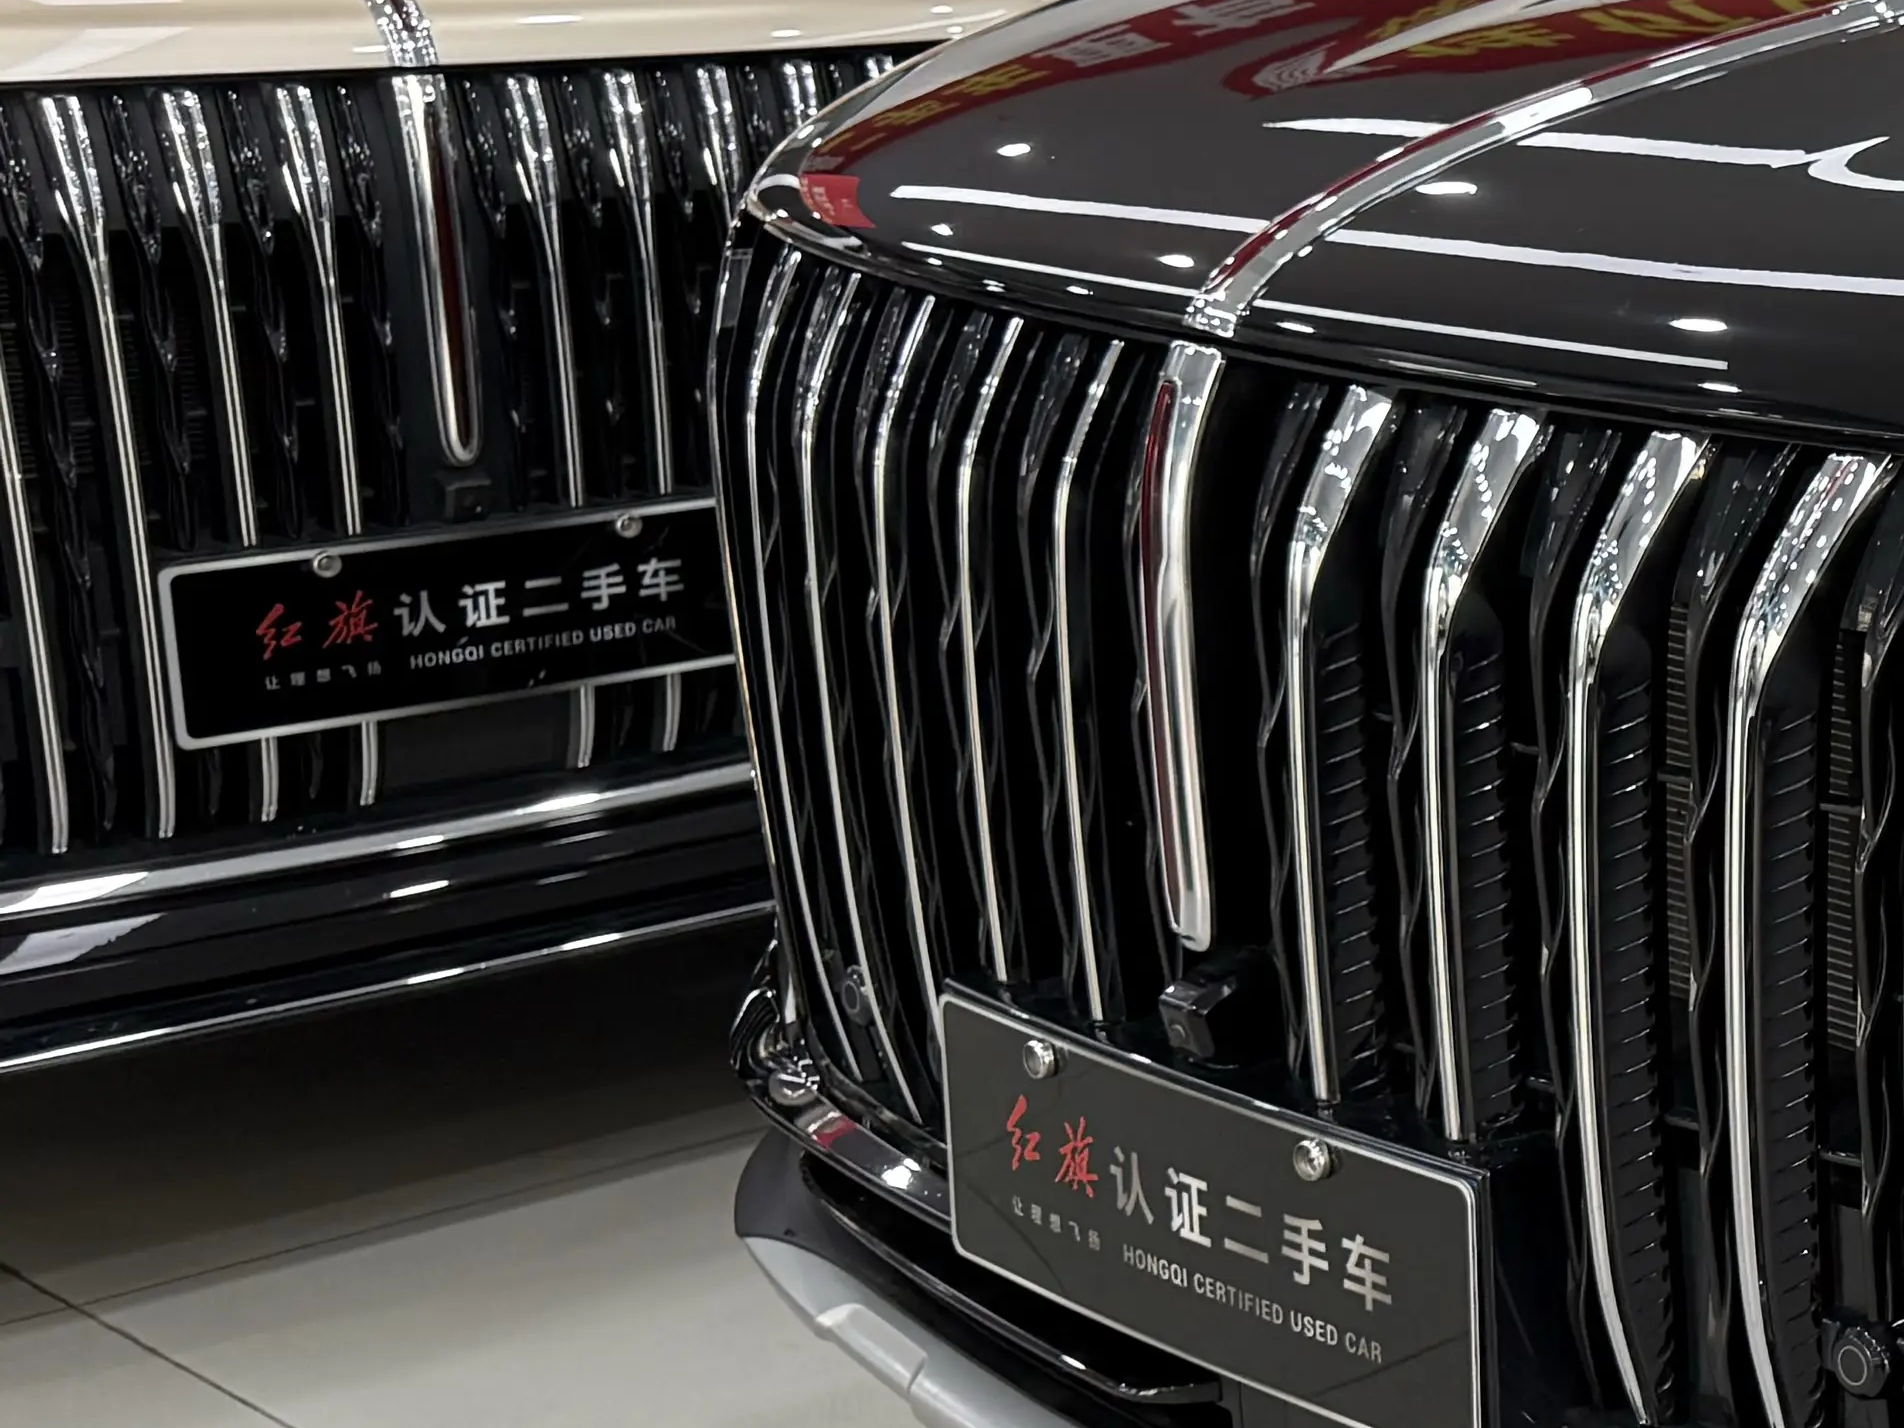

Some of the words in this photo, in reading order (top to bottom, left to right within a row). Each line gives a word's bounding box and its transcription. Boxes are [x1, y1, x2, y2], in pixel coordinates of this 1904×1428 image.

[255, 556, 684, 662] 红旗认证二手车
[409, 644, 484, 670] HONGQI
[490, 628, 584, 659] CERTIFIED
[589, 620, 636, 643] USED
[642, 615, 676, 634] CAR
[1006, 1094, 1393, 1312] 红旗认证二手车
[1122, 1243, 1188, 1288] HONGQI
[1193, 1272, 1284, 1325] CERTIFIED
[1289, 1310, 1338, 1346] USED
[1344, 1331, 1383, 1365] CAR
